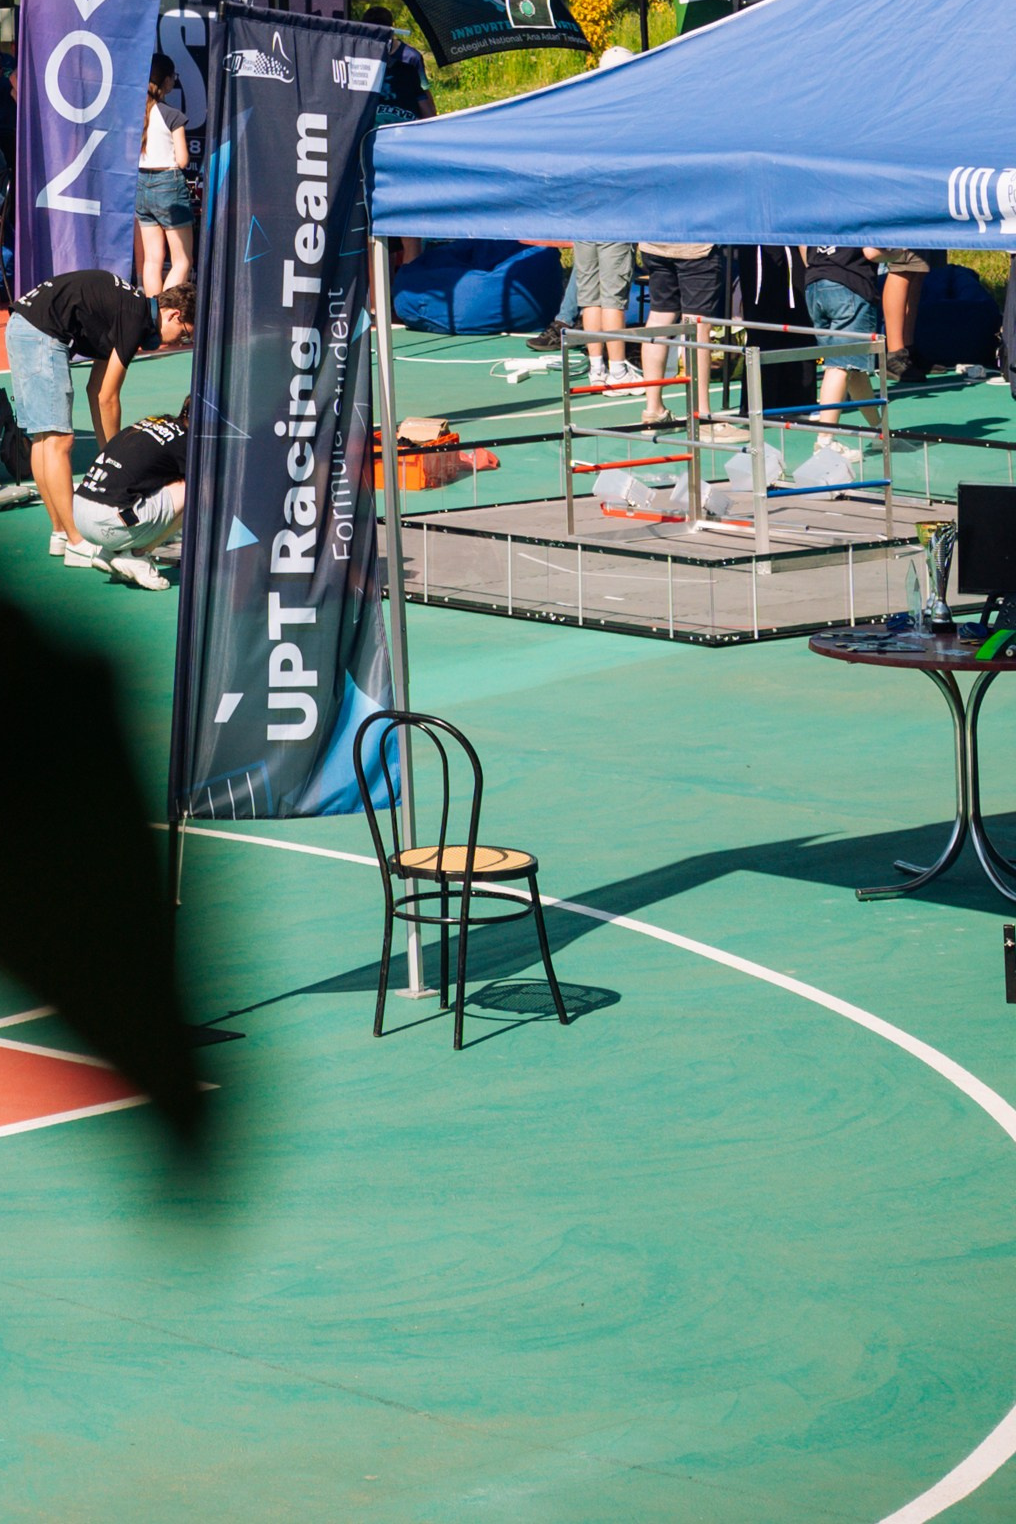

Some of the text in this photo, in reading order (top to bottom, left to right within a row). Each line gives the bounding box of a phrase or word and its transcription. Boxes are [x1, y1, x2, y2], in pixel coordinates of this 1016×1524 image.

[450, 39, 488, 55] Colegiul
[267, 112, 328, 740] UPT Racing Team
